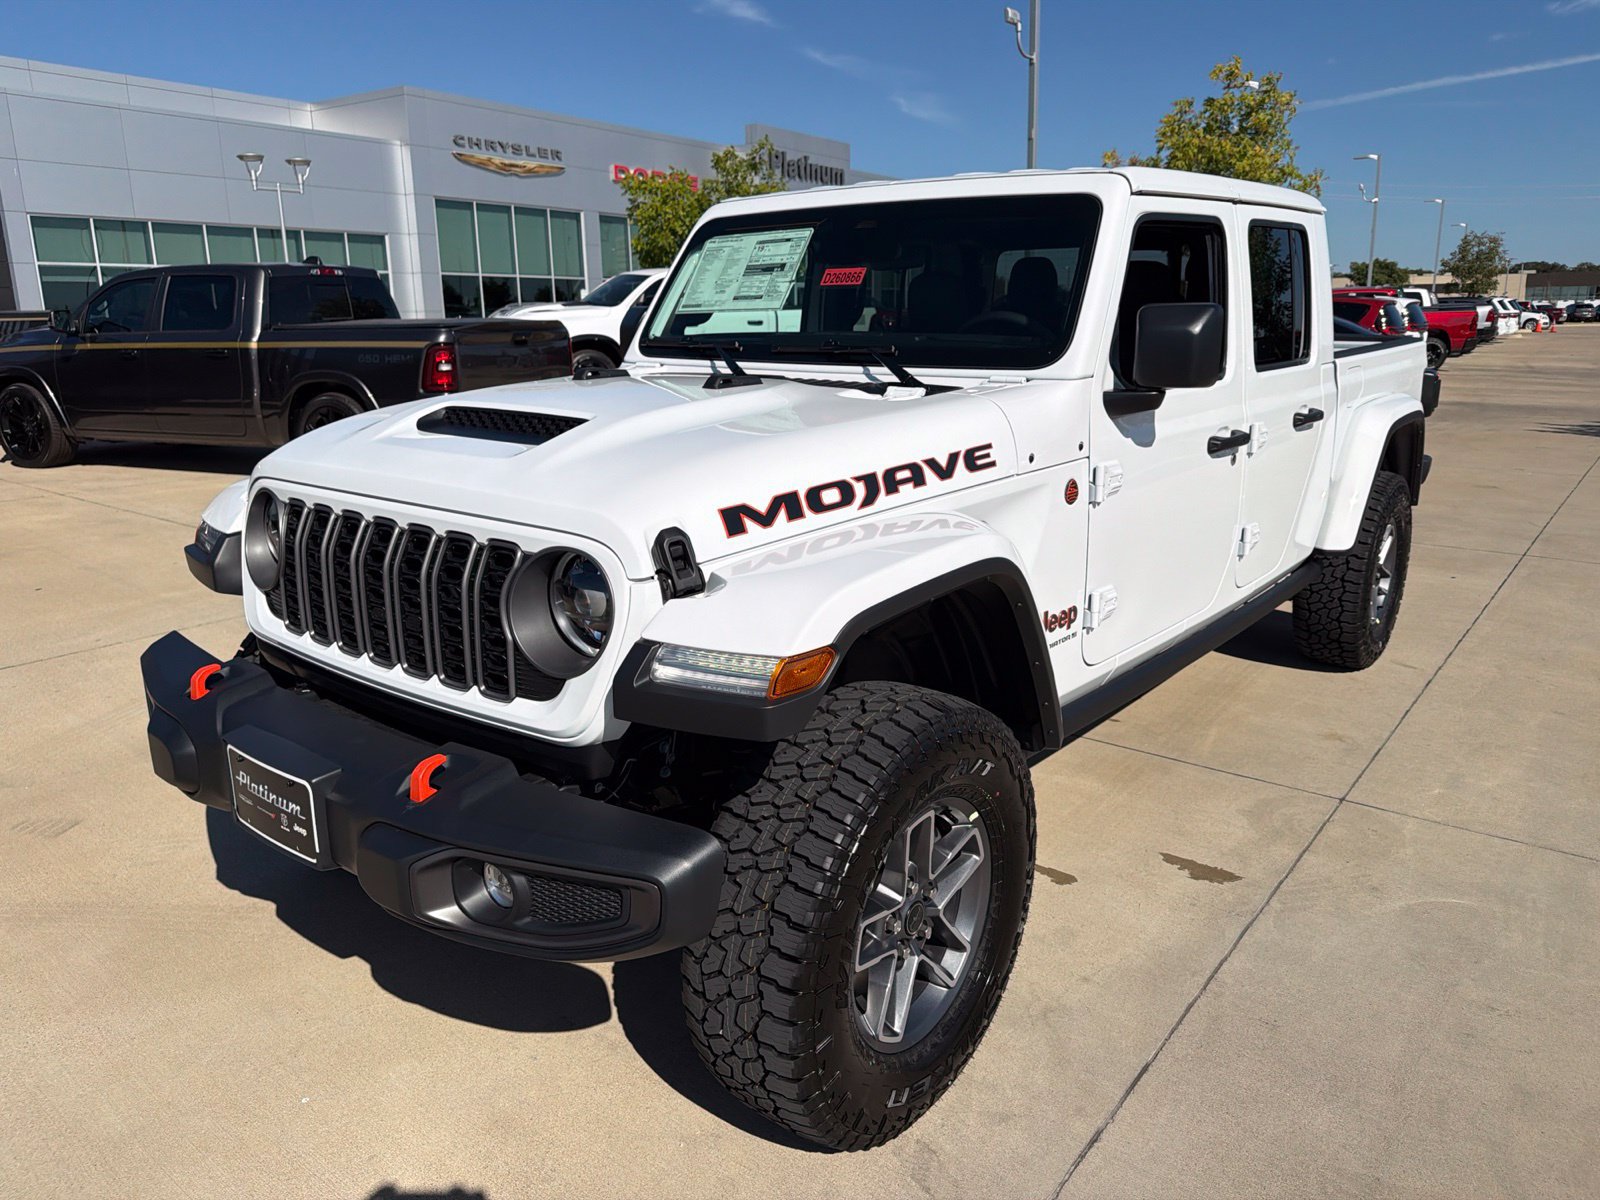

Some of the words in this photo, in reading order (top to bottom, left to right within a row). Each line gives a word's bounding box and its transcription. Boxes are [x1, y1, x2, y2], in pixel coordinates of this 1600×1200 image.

[453, 134, 563, 161] CHRYSLER
[609, 163, 699, 193] DOE
[768, 149, 845, 186] Platinum
[823, 271, 863, 284] D260866
[718, 443, 997, 539] MOJAVE
[1042, 605, 1078, 634] Jeep
[235, 771, 306, 820] Platinum
